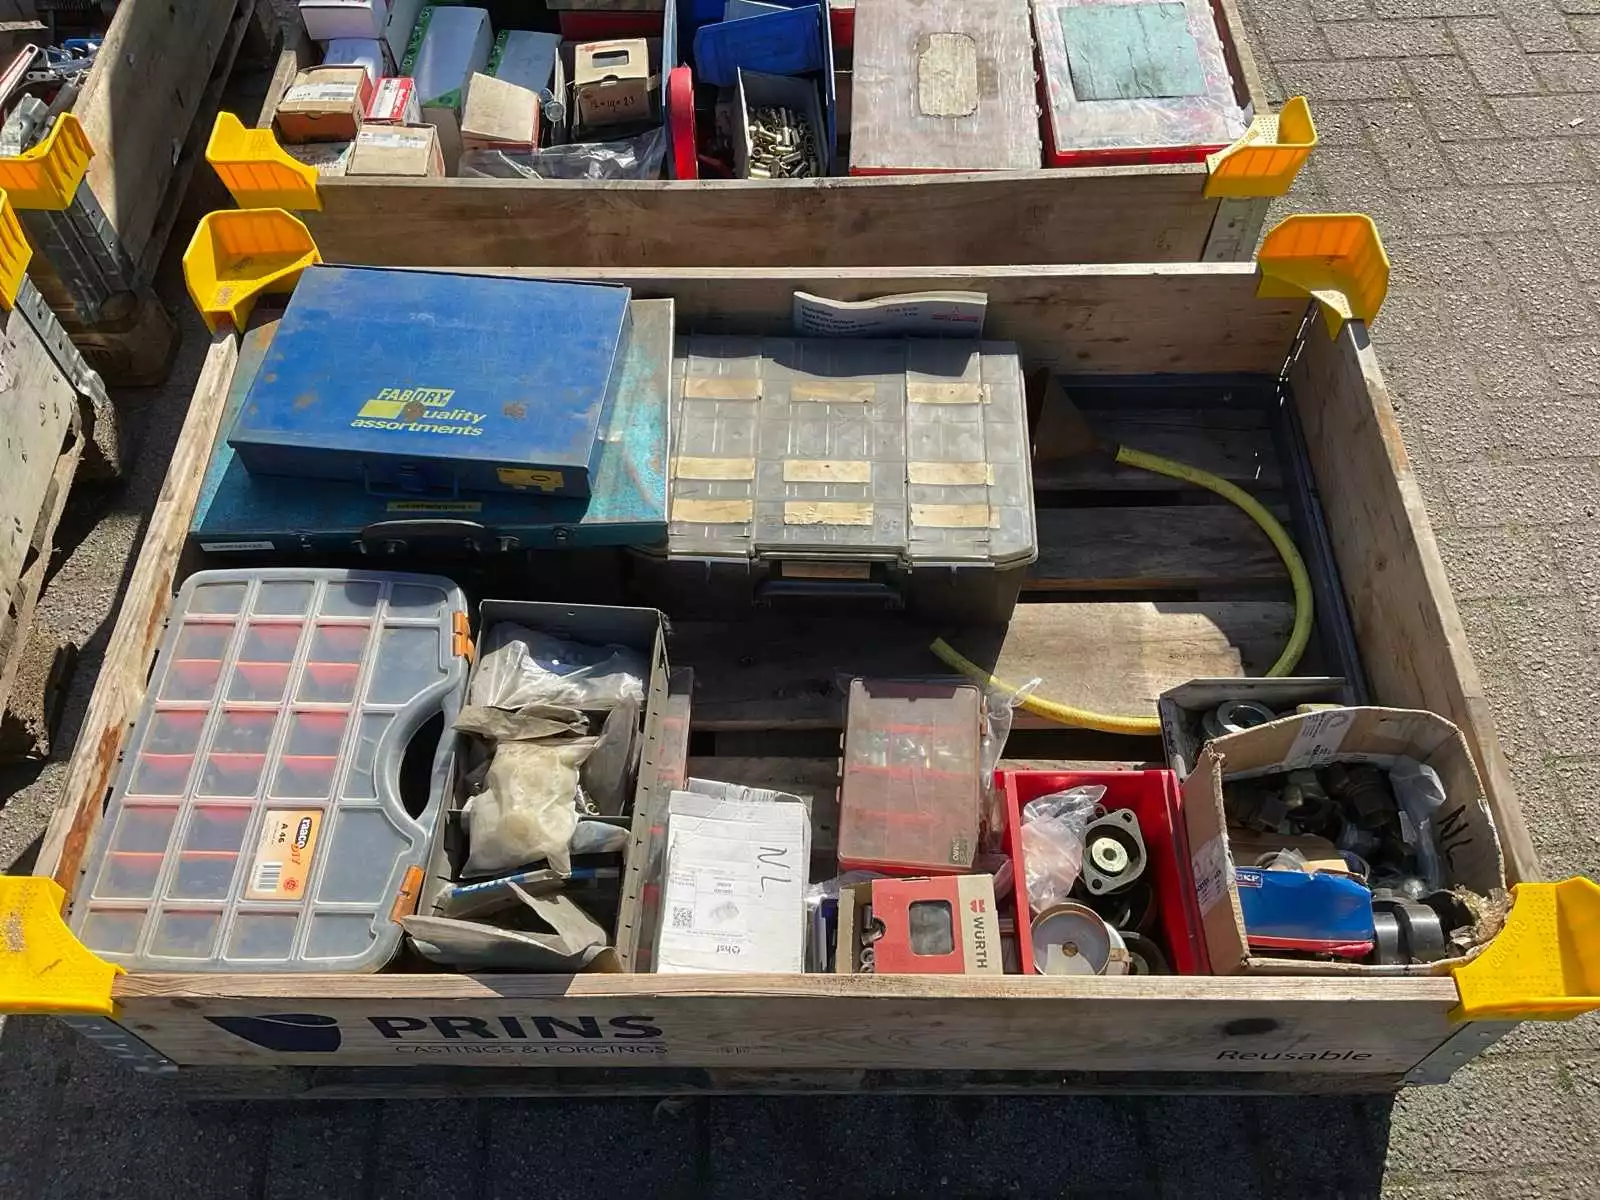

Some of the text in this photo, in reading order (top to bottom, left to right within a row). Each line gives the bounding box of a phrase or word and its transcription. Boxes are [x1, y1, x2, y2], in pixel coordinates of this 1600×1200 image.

[377, 387, 454, 406] FABORY
[419, 407, 487, 424] uality
[350, 419, 484, 436] assortments
[296, 818, 311, 849] raaco
[972, 916, 988, 969] WÜRTH
[367, 1016, 664, 1039] PRINS
[395, 1045, 668, 1054] CASTINGS & FORGINGS
[1216, 1049, 1373, 1061] Reusable
